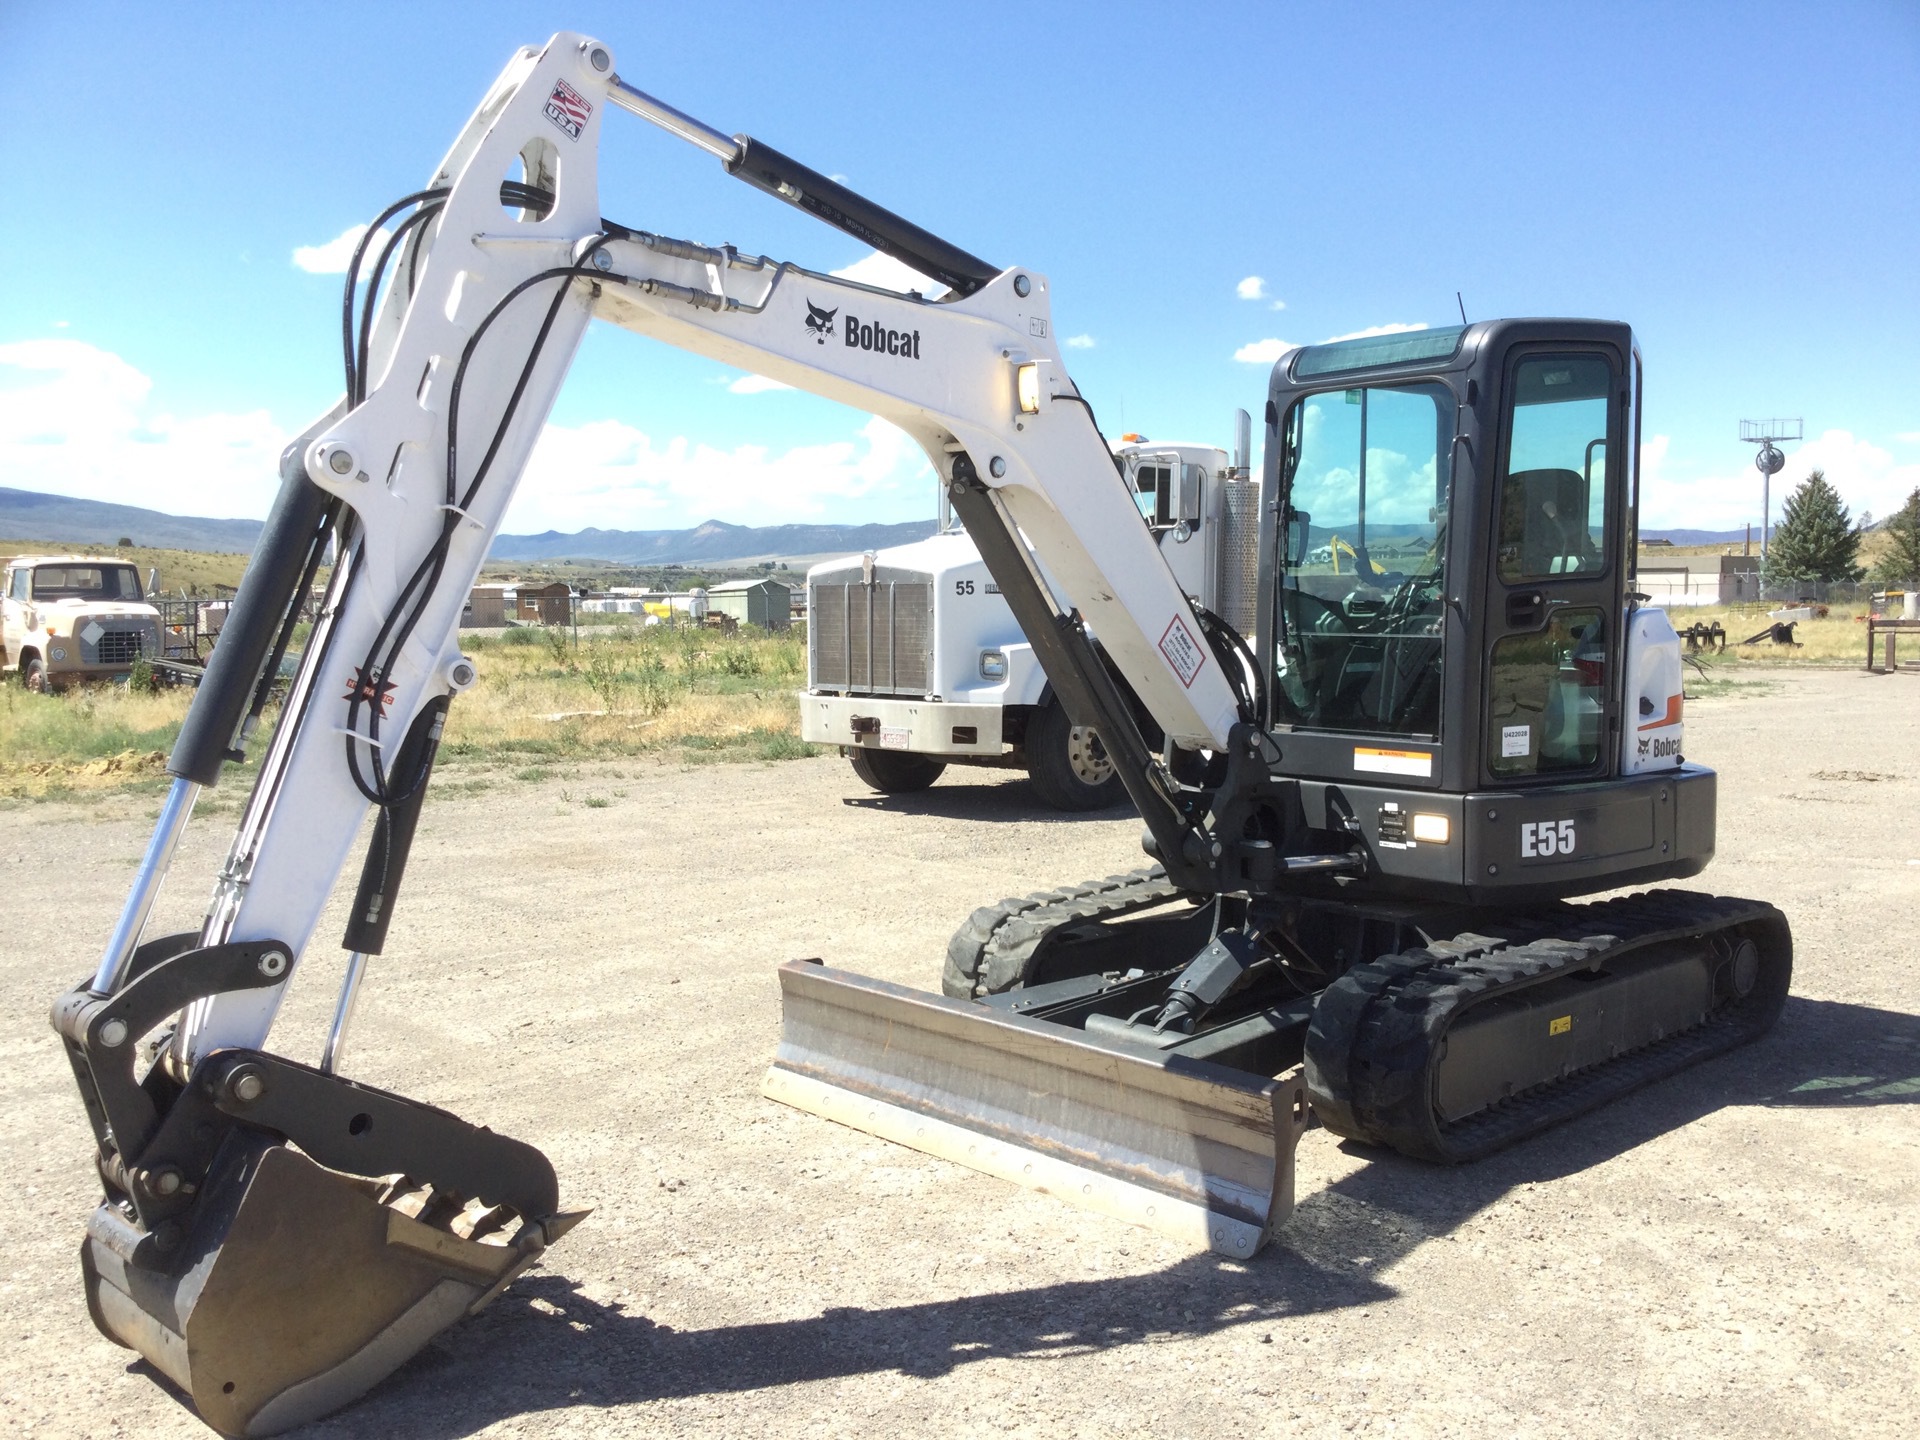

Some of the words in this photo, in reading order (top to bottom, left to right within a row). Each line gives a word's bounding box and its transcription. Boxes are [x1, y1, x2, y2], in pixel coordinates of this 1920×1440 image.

[559, 82, 574, 97] MADE
[579, 100, 589, 111] THE
[546, 103, 576, 136] USA
[845, 315, 920, 360] Bobcat
[955, 580, 975, 596] 55
[1503, 730, 1528, 738] U422028
[1653, 736, 1682, 758] Bobca
[1521, 819, 1576, 858] E55
